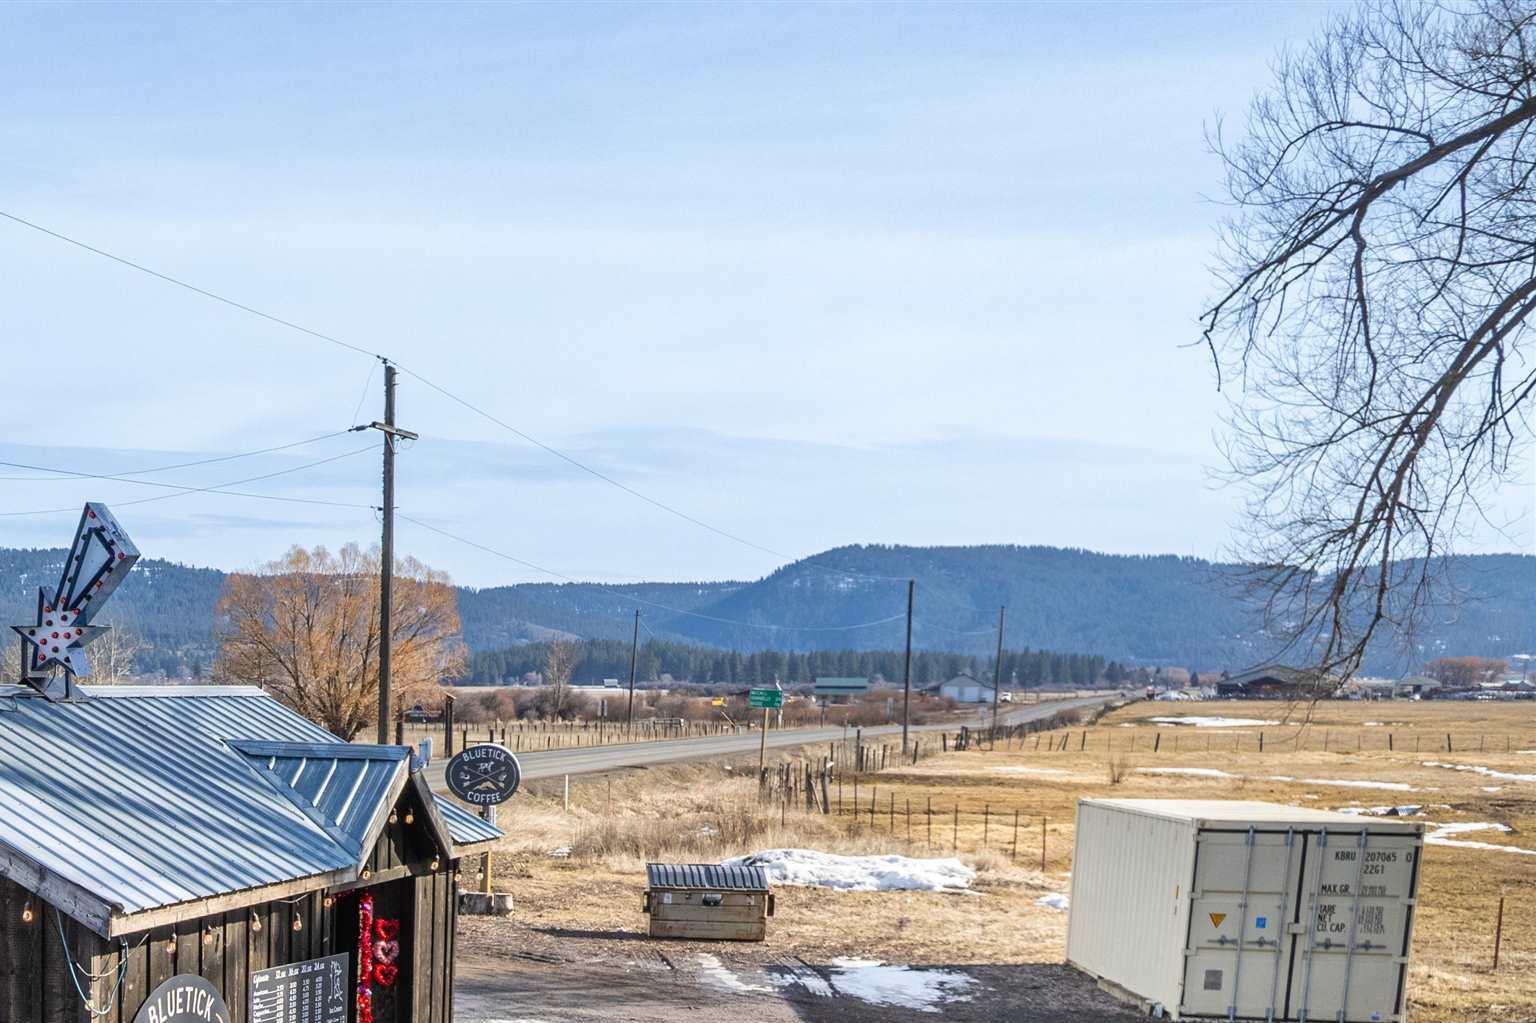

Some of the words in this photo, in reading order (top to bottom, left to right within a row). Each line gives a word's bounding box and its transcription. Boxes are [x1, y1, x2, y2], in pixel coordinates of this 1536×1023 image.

[462, 748, 507, 762] BLUETICK
[467, 791, 502, 803] COFFEE
[1334, 851, 1356, 861] KBRU
